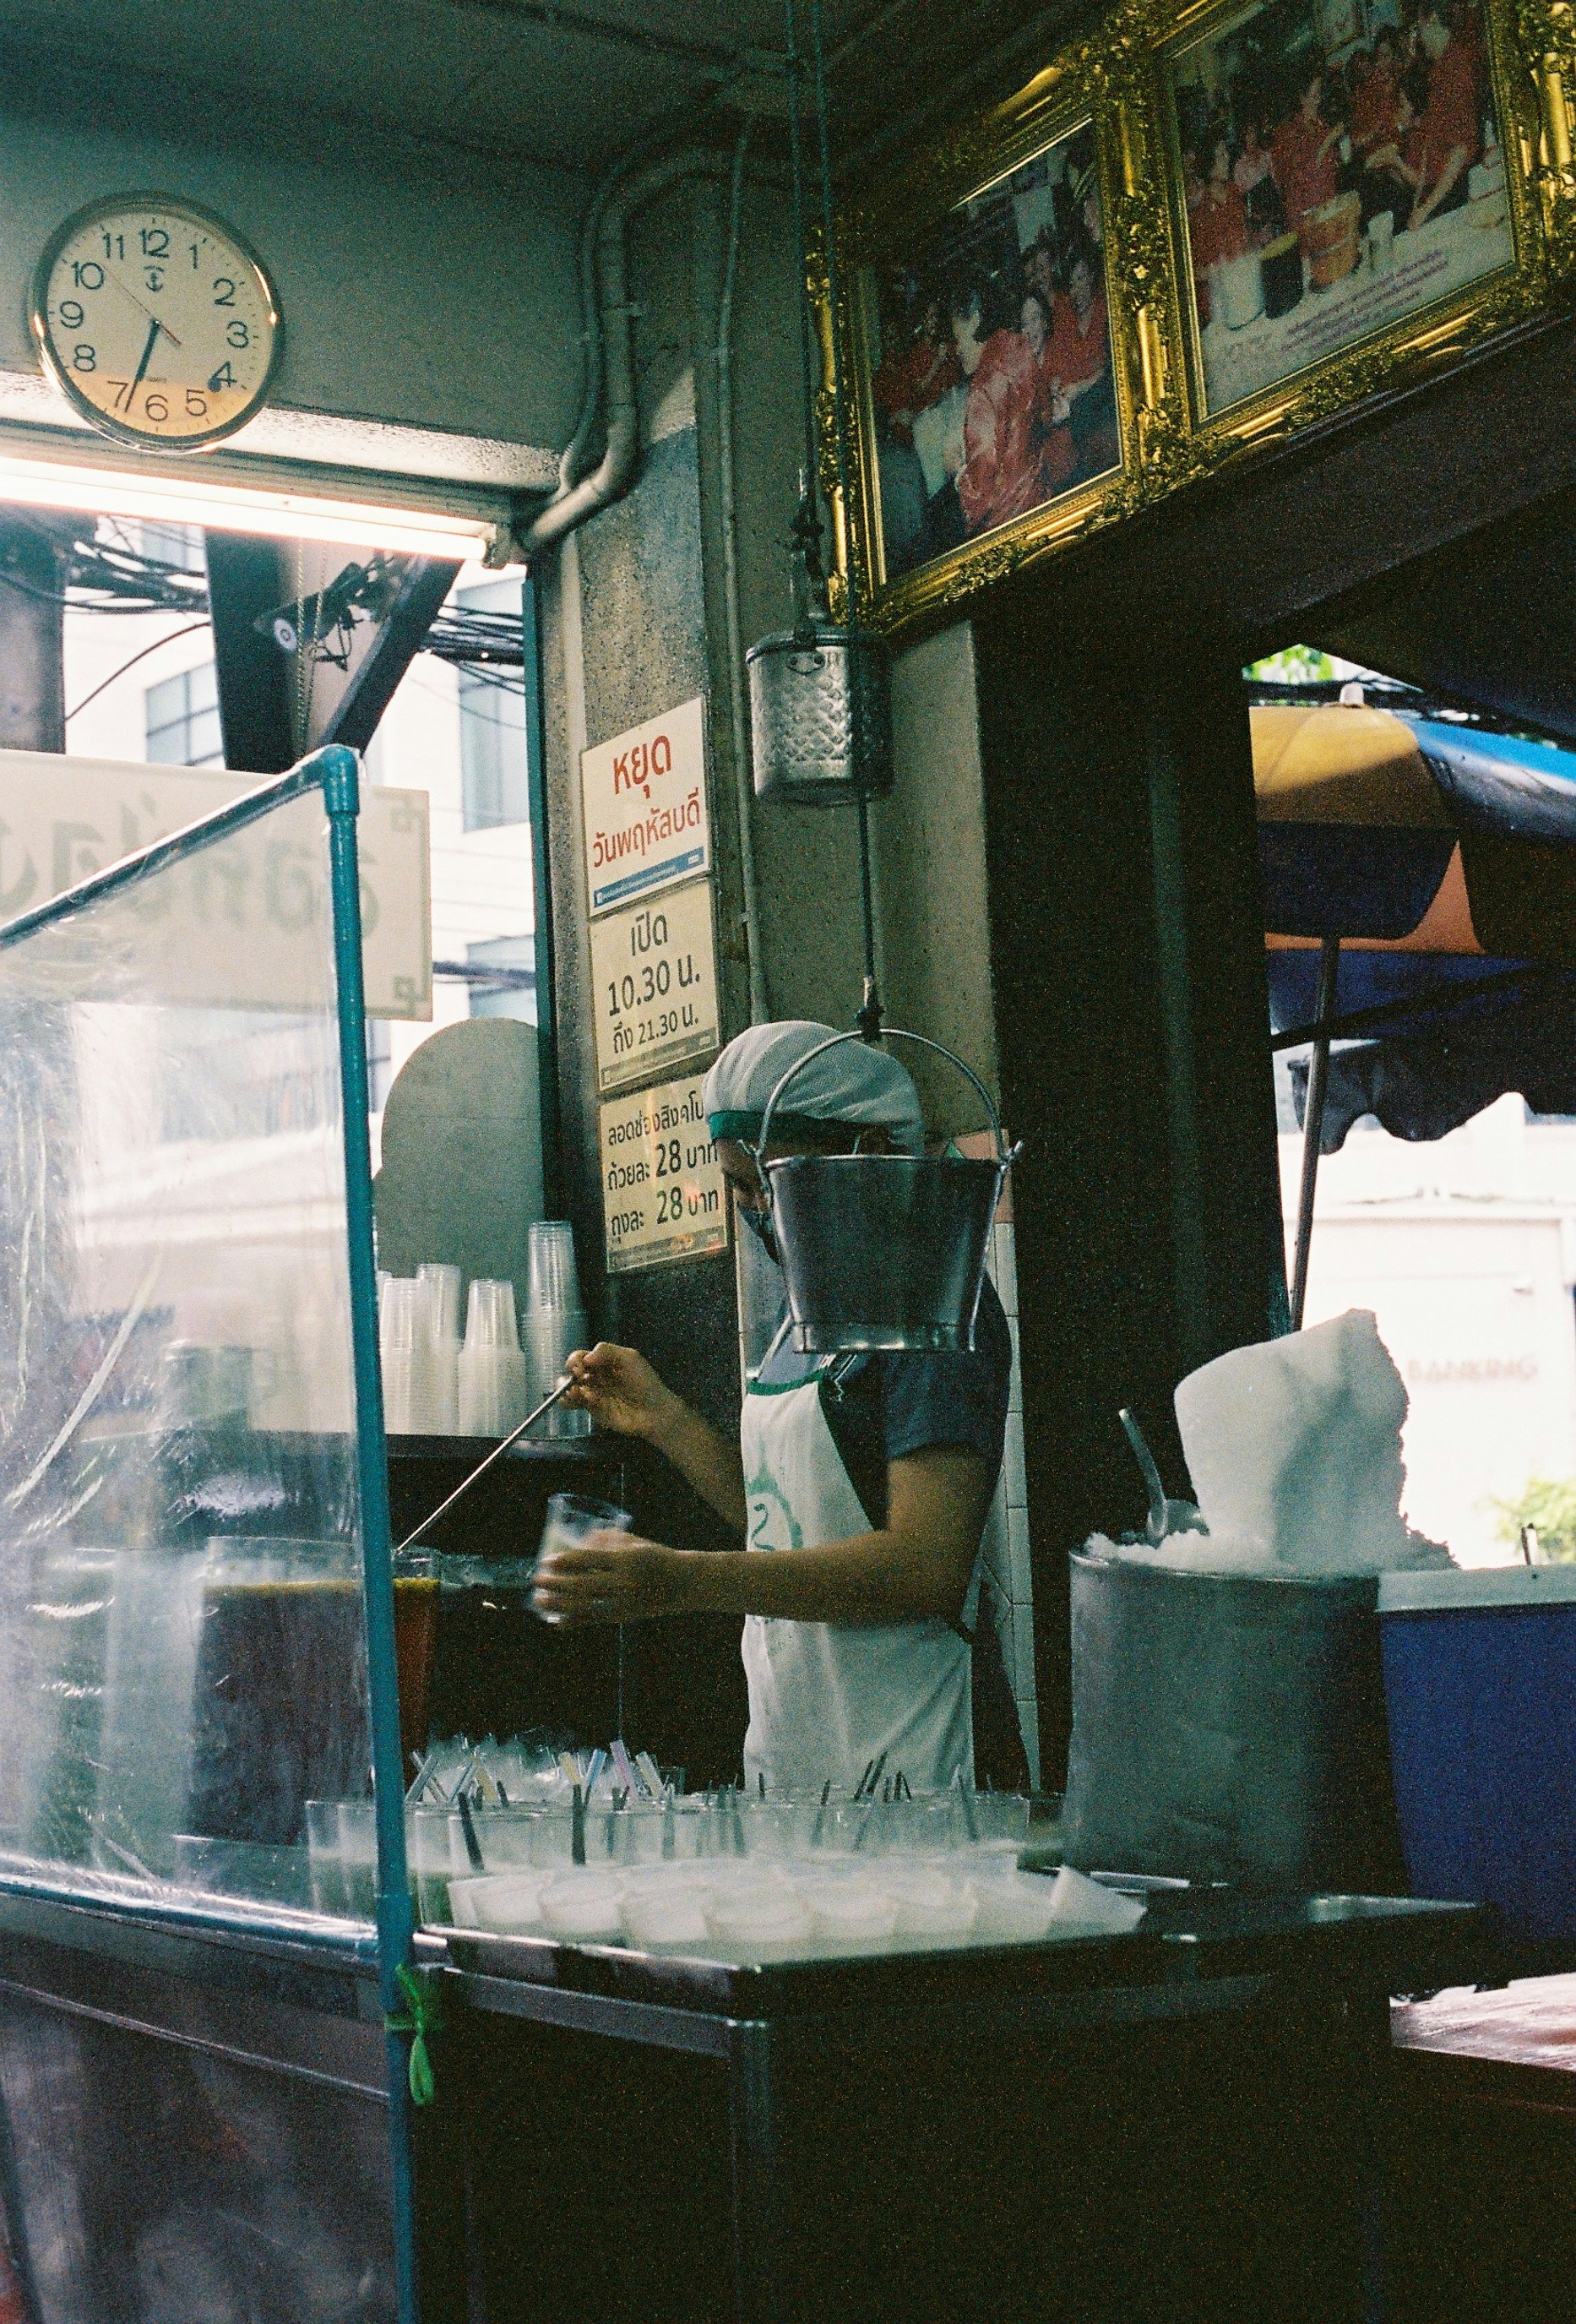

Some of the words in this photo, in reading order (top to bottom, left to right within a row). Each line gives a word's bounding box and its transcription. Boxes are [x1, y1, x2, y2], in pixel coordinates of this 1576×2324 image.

[102, 232, 125, 260] 11
[139, 228, 170, 259] 12
[189, 243, 198, 269] 1
[71, 261, 105, 290] 10
[213, 278, 236, 307] 2
[59, 301, 84, 329] 9
[226, 321, 250, 349] 3
[73, 344, 96, 373] 8
[210, 361, 237, 388] 4
[107, 380, 128, 408] 7
[144, 395, 169, 422] 6
[185, 389, 207, 416] 5
[613, 735, 671, 799] หยุด
[593, 786, 701, 868] วันพฤหัสบดี
[631, 911, 668, 956] เปิด
[608, 960, 671, 1016] 10.30
[677, 955, 701, 988] น.
[613, 1021, 633, 1053] ถึง
[638, 1010, 678, 1045] 21.30
[682, 1004, 698, 1028] น.
[608, 1090, 704, 1146] ลอดช่องสิงคโป
[608, 1162, 650, 1190] ถ้วยละ
[655, 1139, 682, 1178] 28
[687, 1138, 718, 1168] บาท
[611, 1210, 644, 1244] ถุงละ
[656, 1186, 682, 1224] 28
[687, 1189, 719, 1216] บาท
